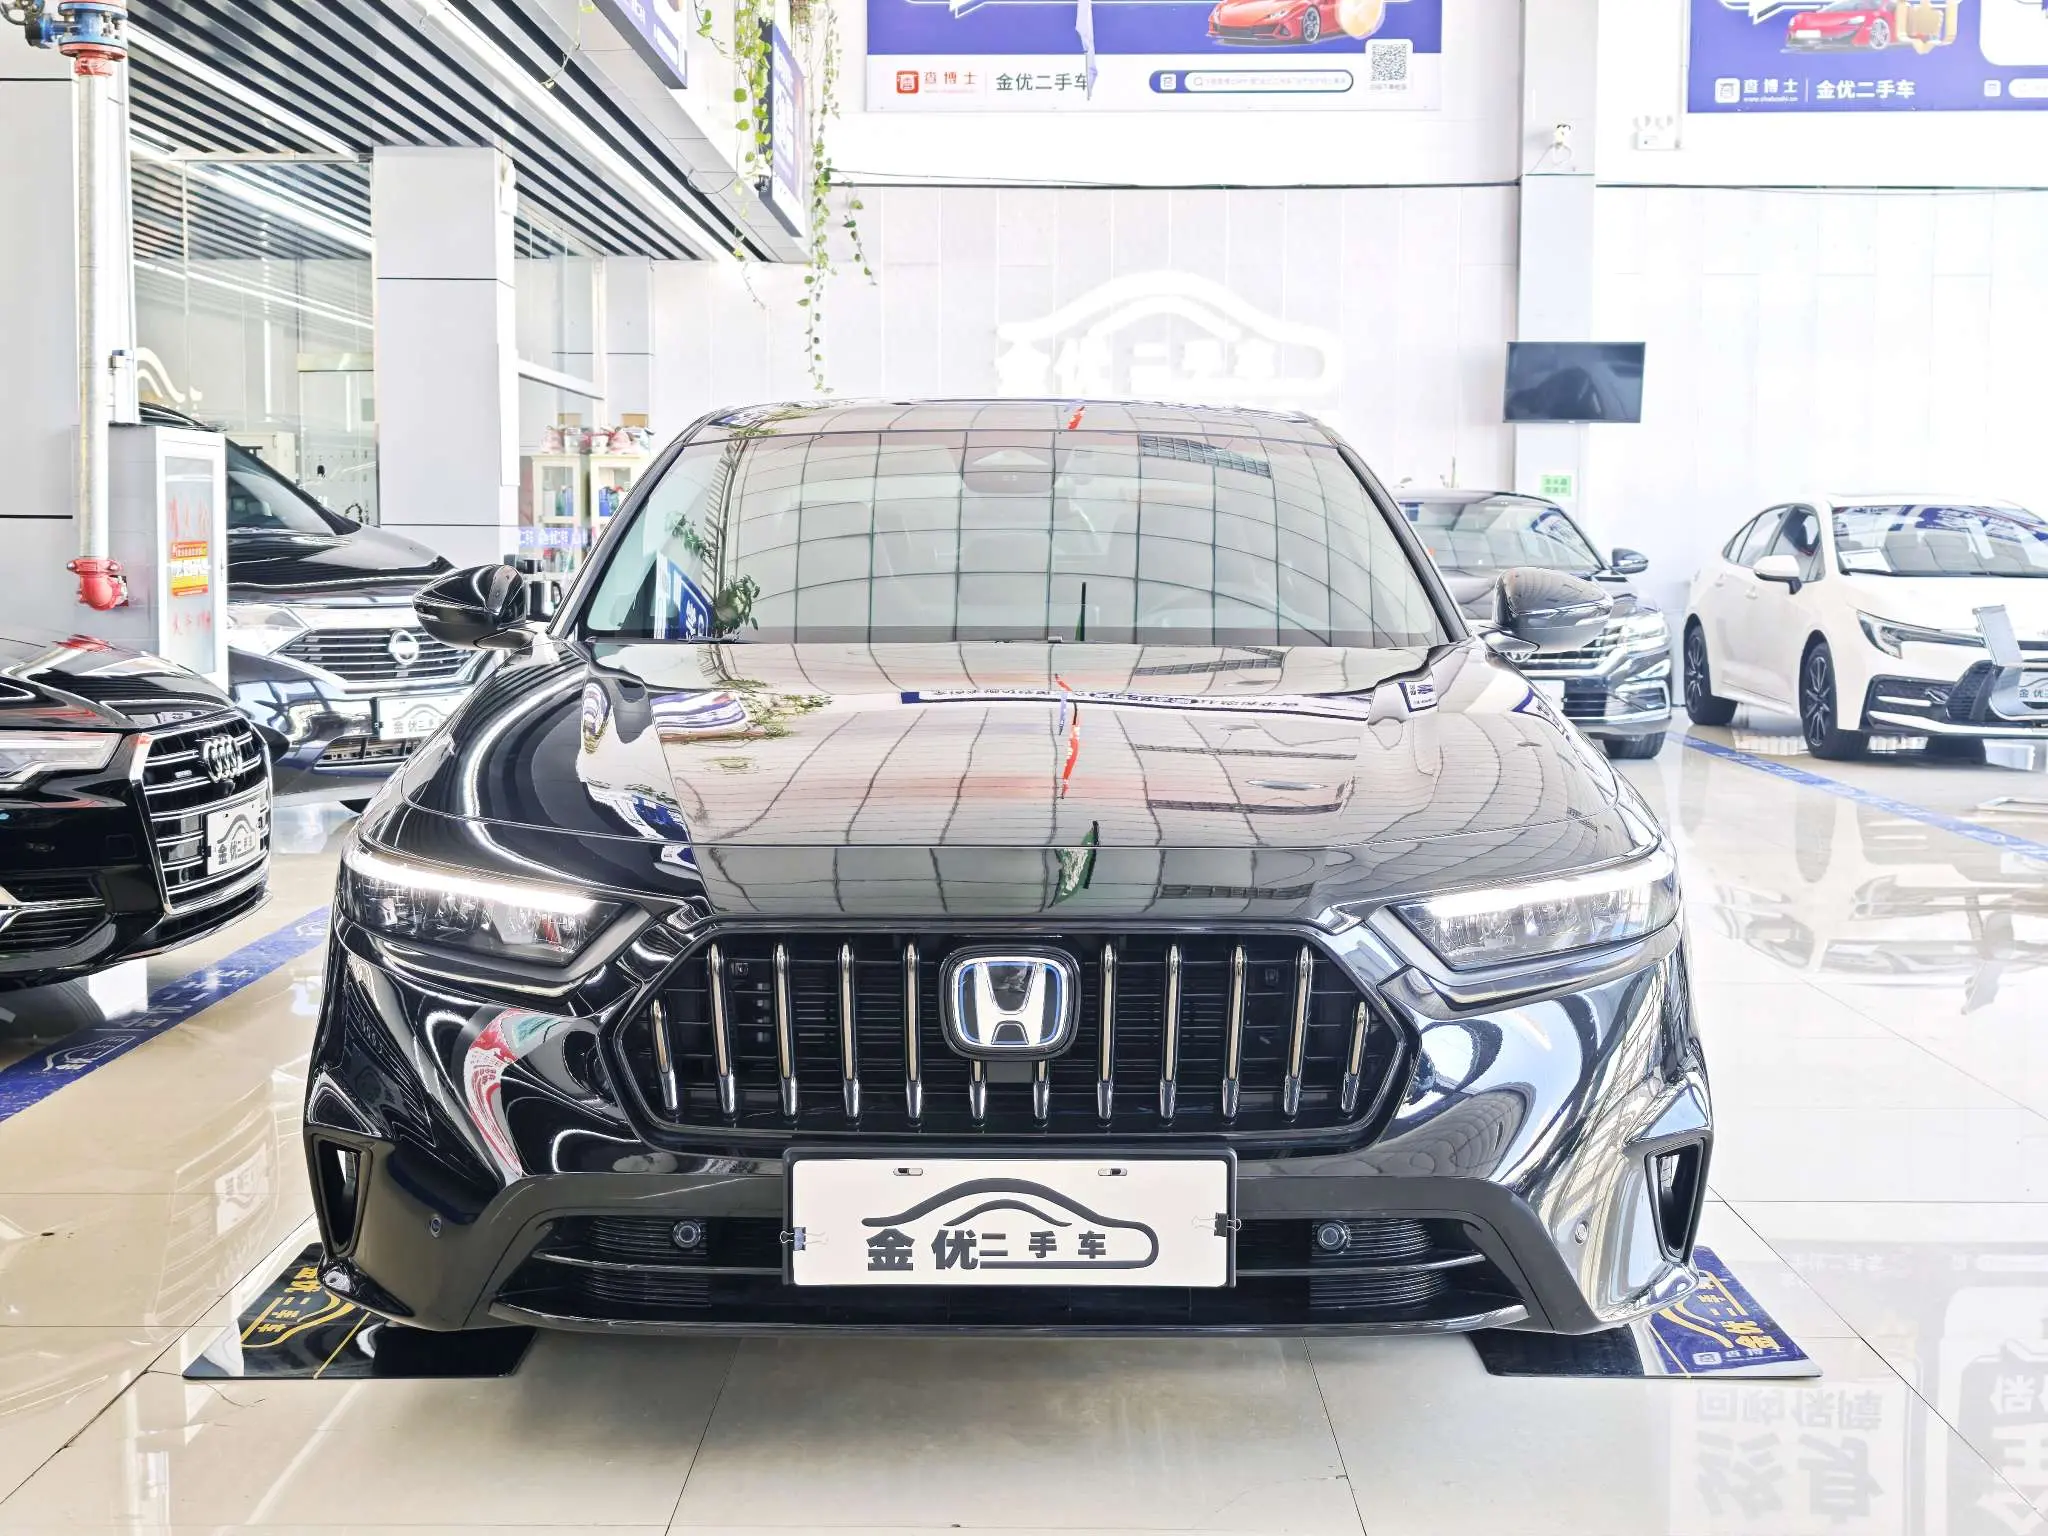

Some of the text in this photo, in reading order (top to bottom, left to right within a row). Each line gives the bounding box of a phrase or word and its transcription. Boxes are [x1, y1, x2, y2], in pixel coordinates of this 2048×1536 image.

[1816, 79, 1916, 99] 金优二手车
[866, 1228, 1108, 1272] 金优二手车
